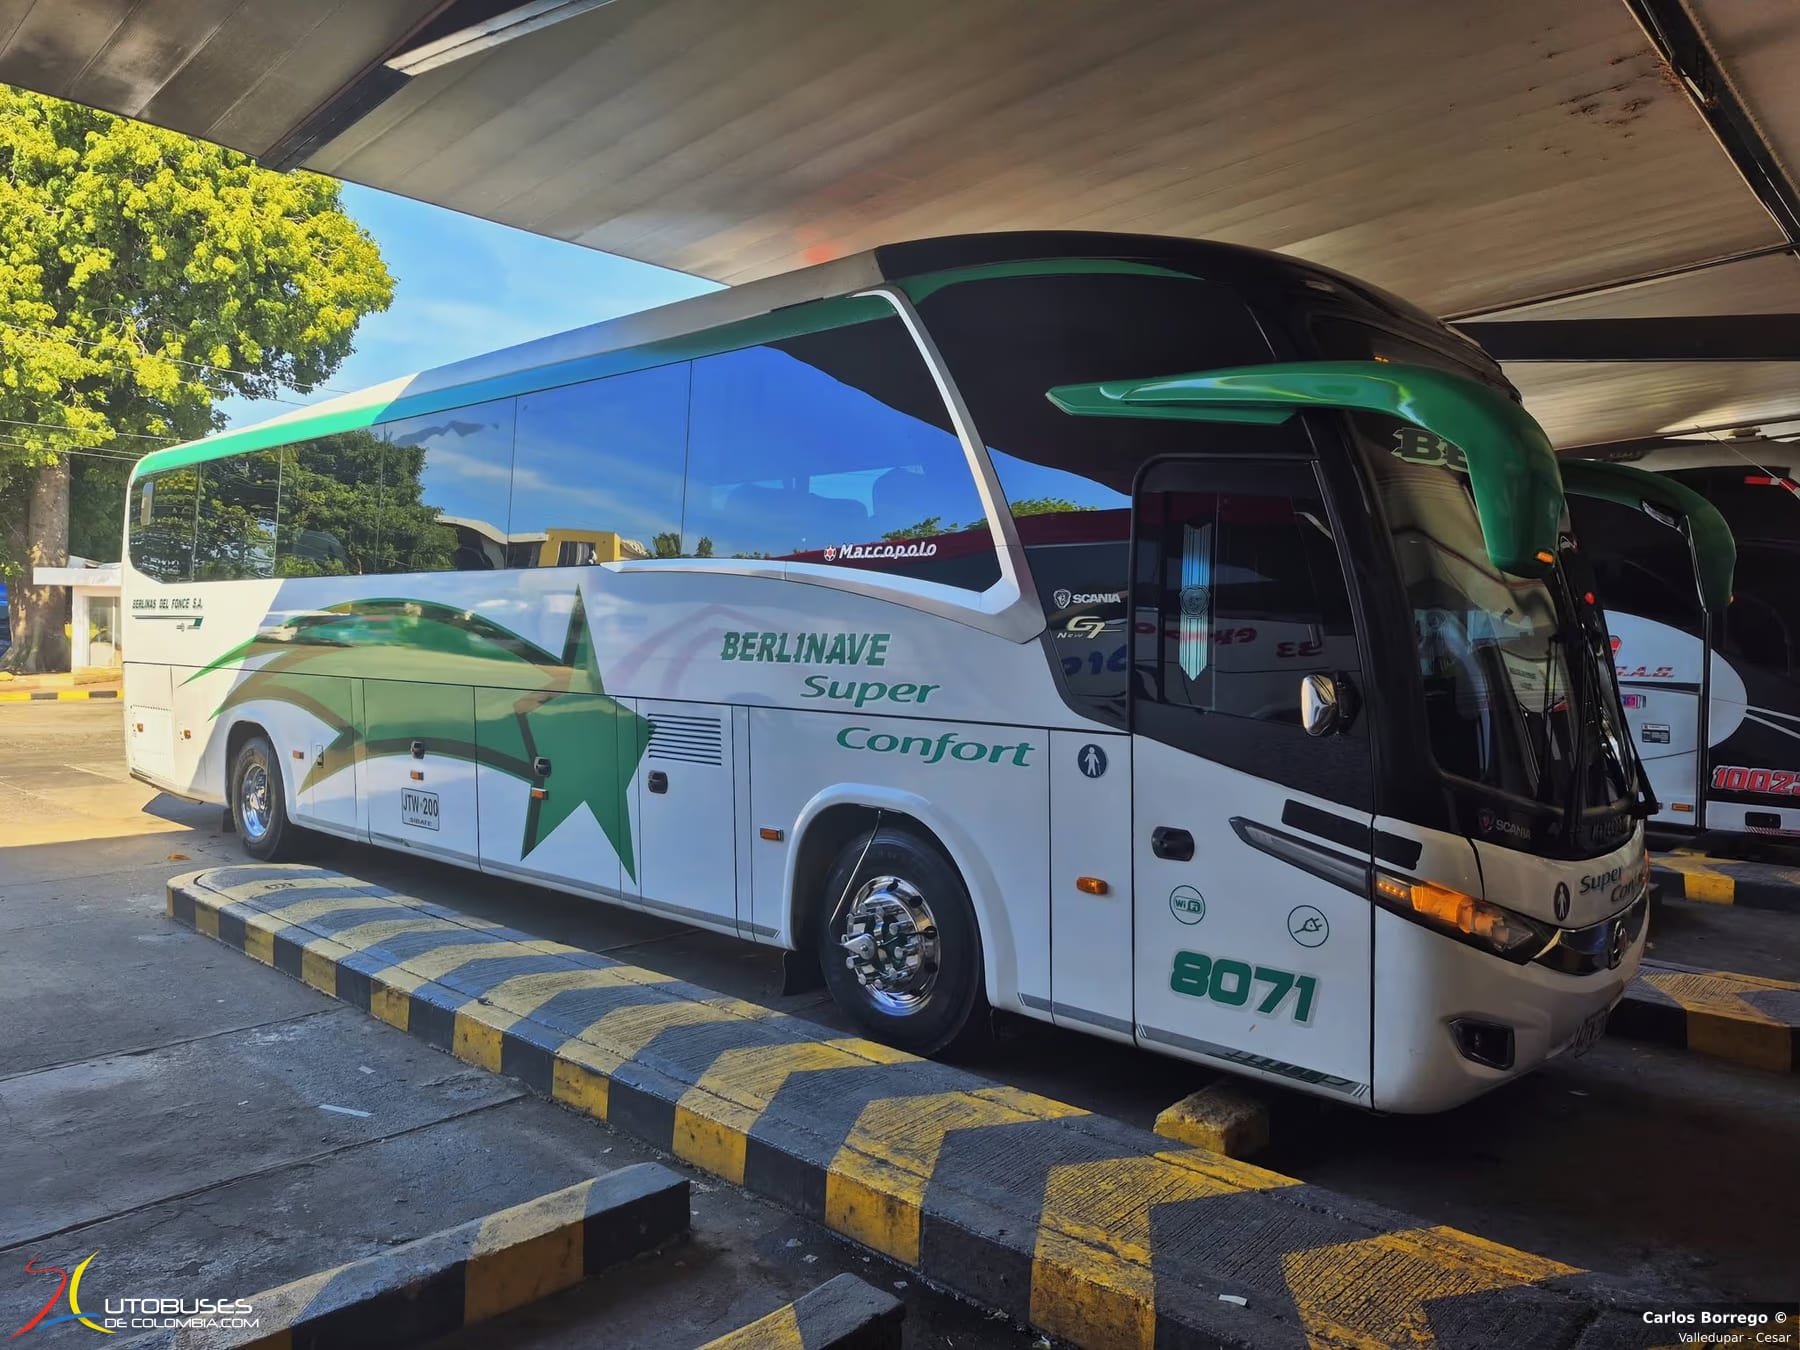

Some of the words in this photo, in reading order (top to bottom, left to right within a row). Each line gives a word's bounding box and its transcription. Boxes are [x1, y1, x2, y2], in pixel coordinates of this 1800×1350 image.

[839, 541, 937, 560] Marcopolo
[1072, 593, 1121, 604] SCANIA
[721, 631, 891, 666] BERLINAVE
[800, 675, 940, 708] Super
[836, 727, 1036, 767] Confort
[1496, 819, 1531, 840] SCANIA
[1170, 951, 1317, 1022] 8071
